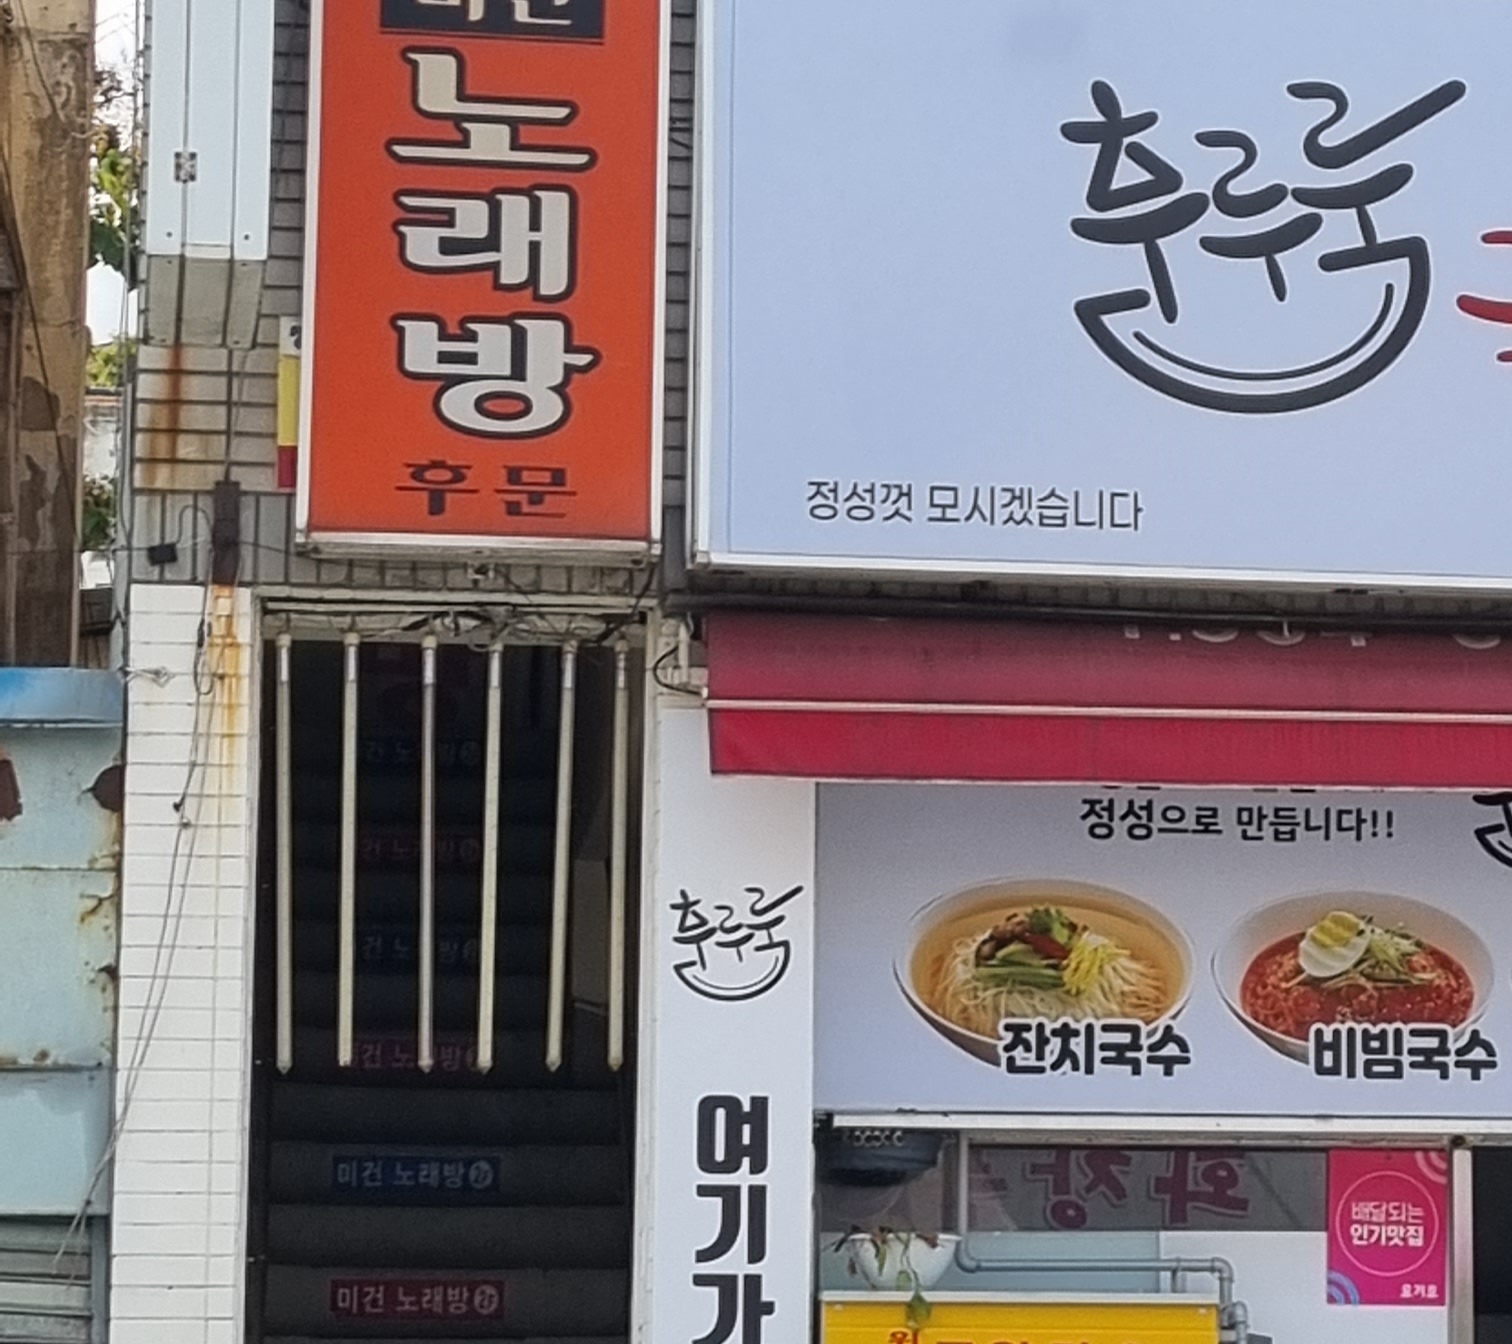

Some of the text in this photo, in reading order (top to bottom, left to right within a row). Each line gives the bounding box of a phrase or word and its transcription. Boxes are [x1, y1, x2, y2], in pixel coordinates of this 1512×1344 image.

[388, 47, 600, 438] 노래방
[1060, 80, 1466, 414] 후루룩
[395, 459, 578, 518] 후문
[806, 480, 1144, 532] 정성껏 모시겠습니다
[1079, 797, 1395, 843] 정성으로 만듭니다!!
[670, 885, 804, 1001] 후루룩
[1000, 1021, 1192, 1077] 잔치국수
[1312, 1024, 1498, 1081] 비빔국수
[336, 1159, 383, 1188] 미건
[392, 1159, 466, 1190] 노래방
[1350, 1224, 1425, 1247] 인기맛집
[1351, 1201, 1425, 1223] 배달되는
[336, 1285, 385, 1315] 미건
[397, 1285, 470, 1316] 노래방
[1399, 1283, 1439, 1299] 요기요
